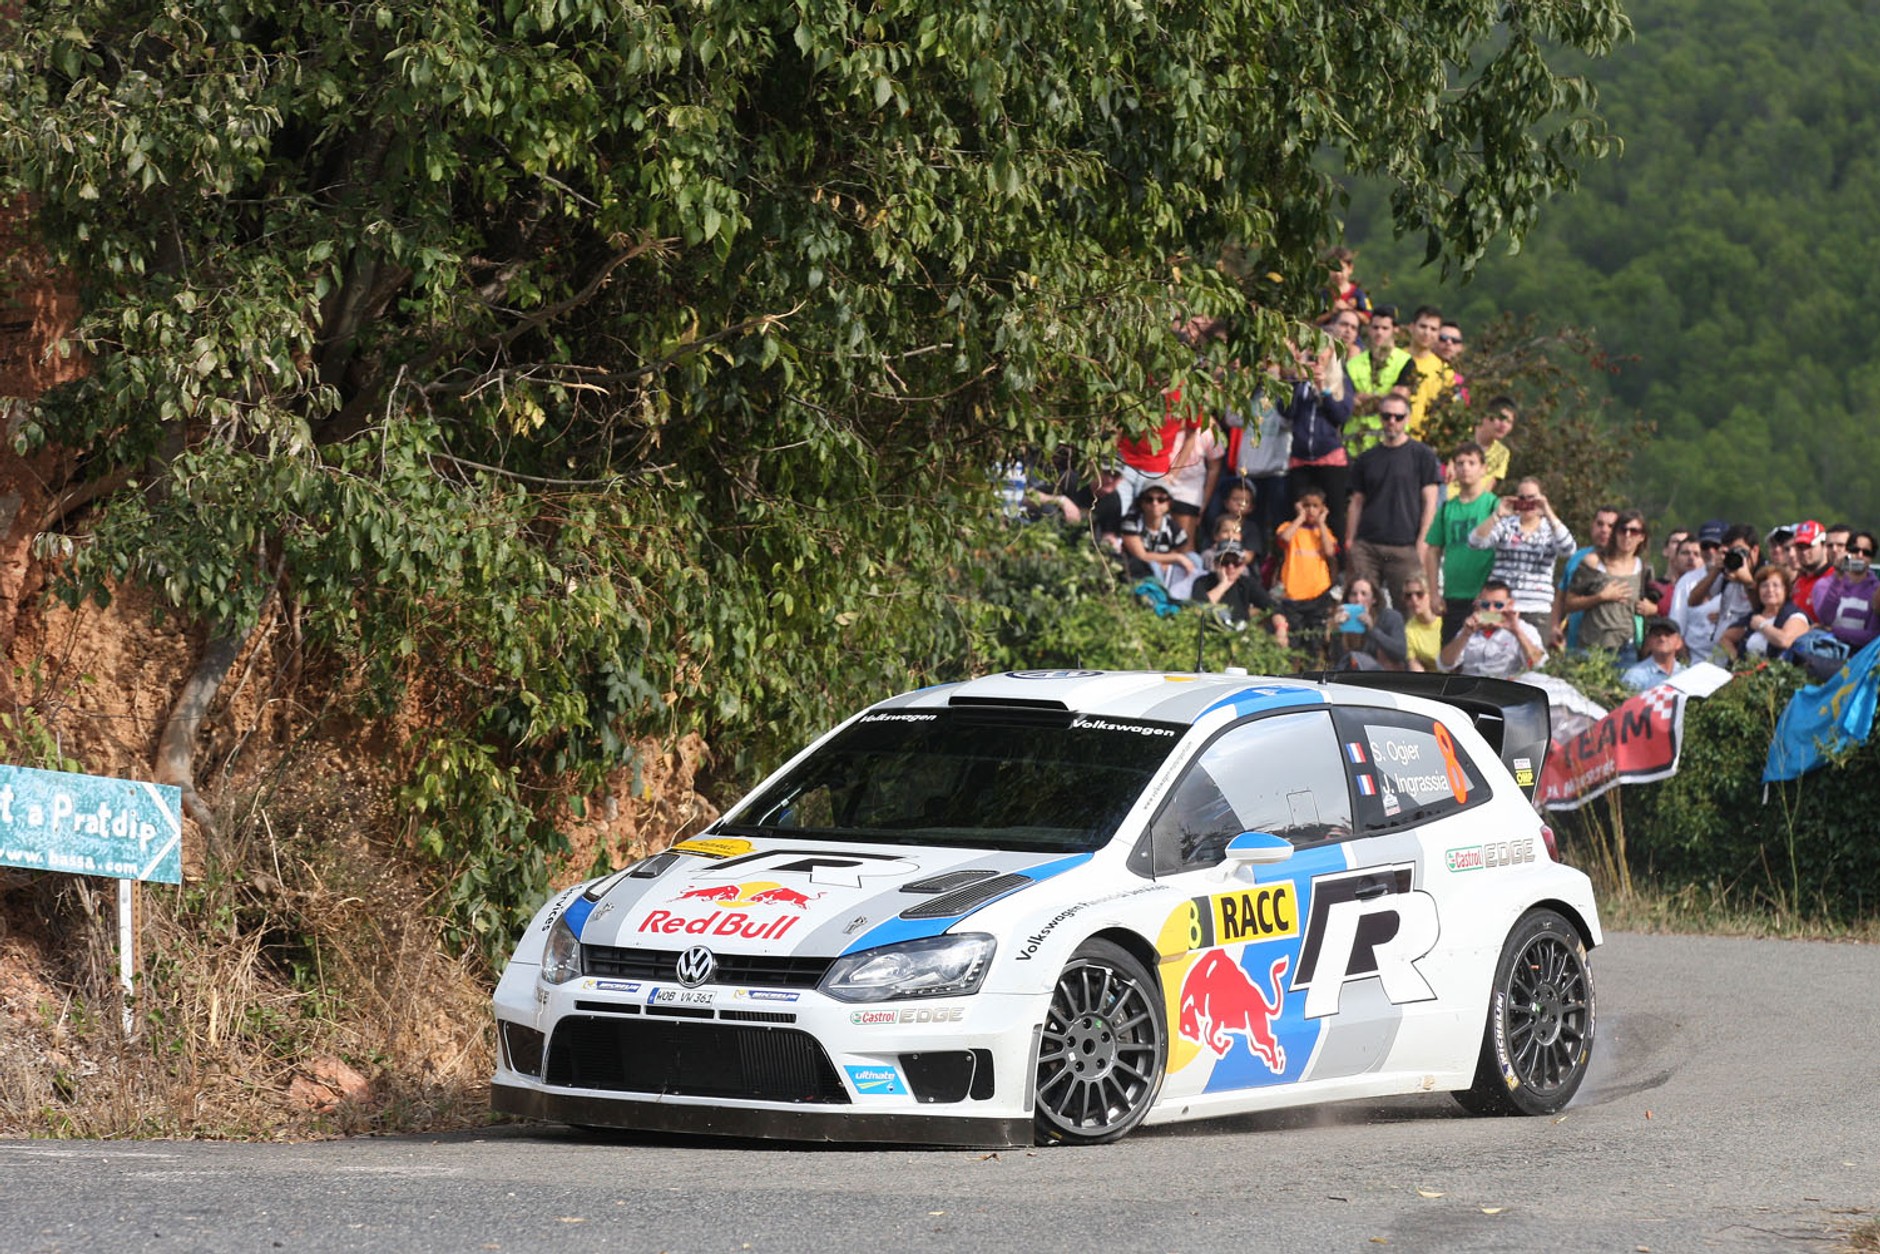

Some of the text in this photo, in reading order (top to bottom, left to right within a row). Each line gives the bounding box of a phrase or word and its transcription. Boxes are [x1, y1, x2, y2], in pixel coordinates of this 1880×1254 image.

[1073, 719, 1175, 737] Volkswagen
[1372, 740, 1420, 766] S. Ogier
[1434, 722, 1468, 804] 8
[1383, 770, 1450, 796] J. Ingrassia
[28, 804, 43, 826] a
[53, 794, 157, 850] Pratdip
[1455, 839, 1535, 868] Castrol EDGE
[638, 911, 800, 940] Red Bull
[1220, 889, 1289, 940] RACC
[1015, 902, 1082, 961] Volkswagen
[862, 1007, 965, 1024] Castrol EDGE
[855, 1070, 896, 1081] ultimate
